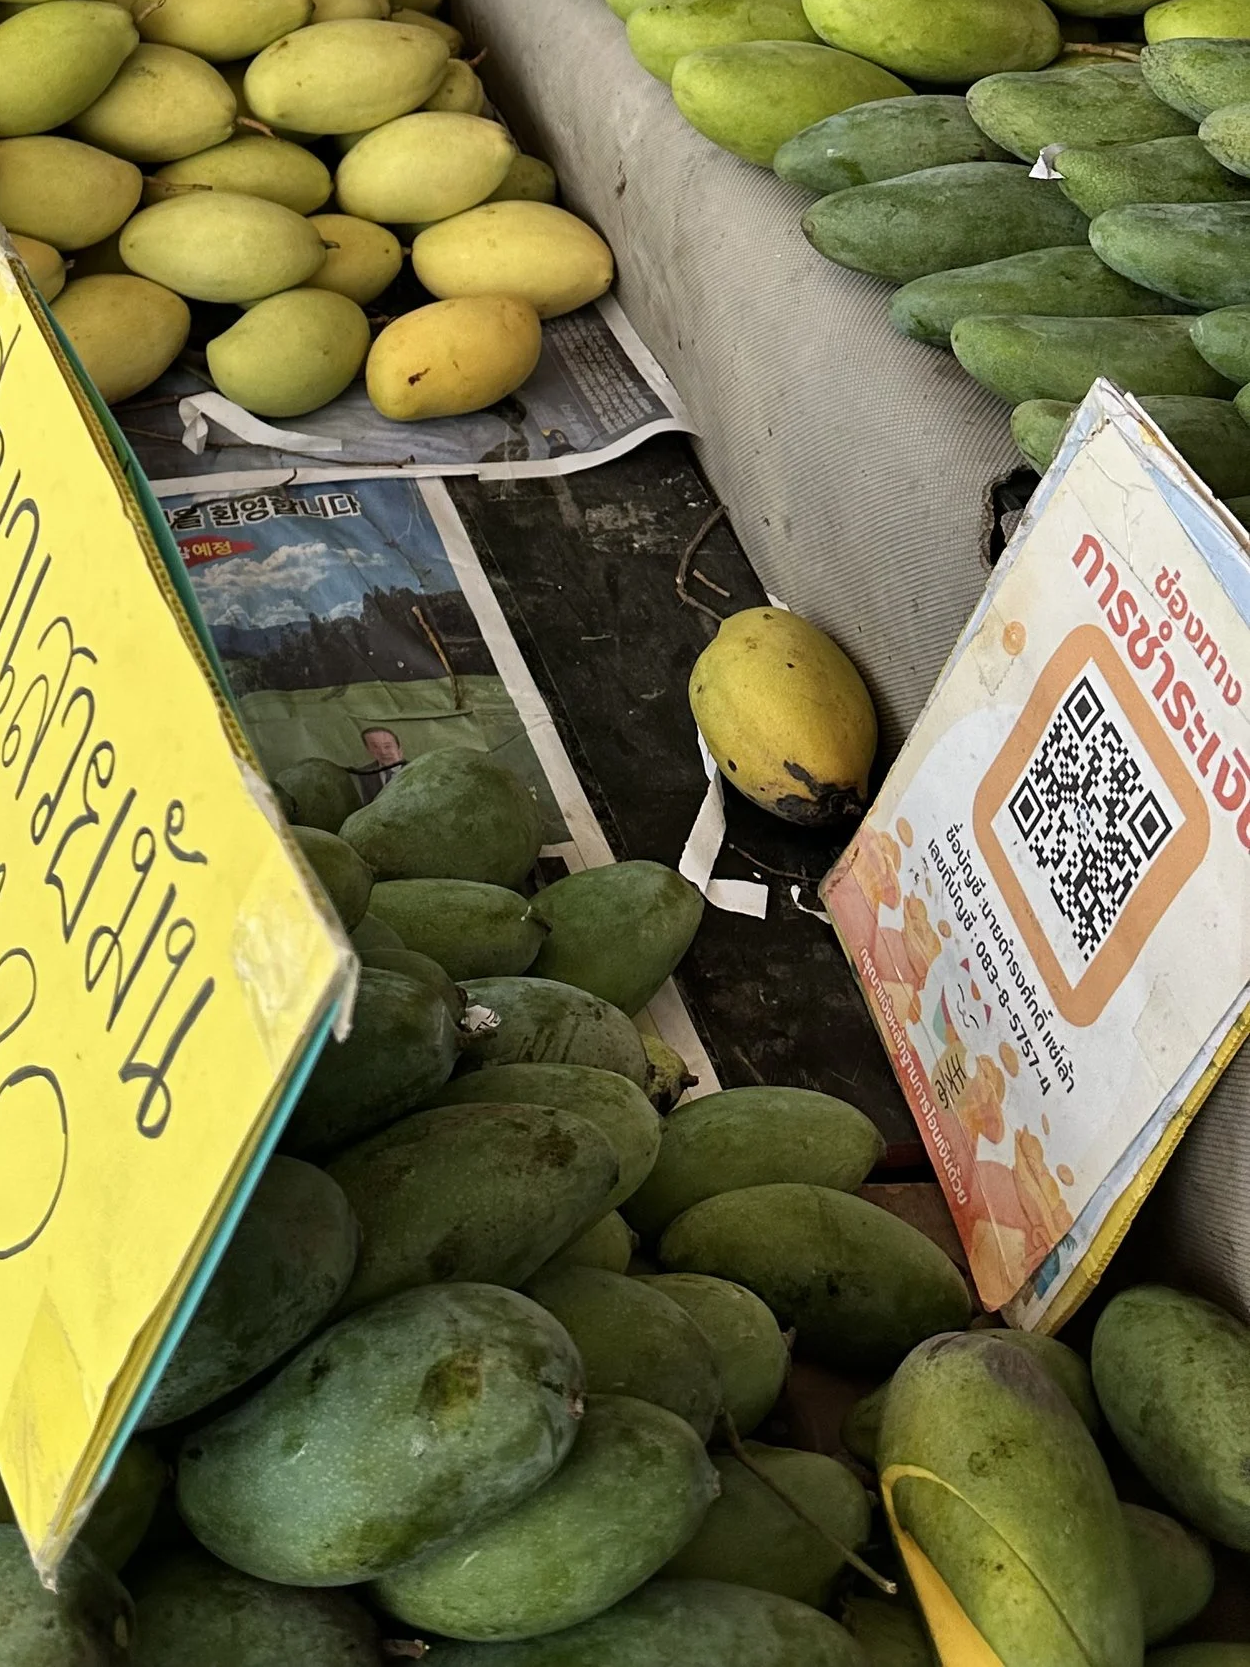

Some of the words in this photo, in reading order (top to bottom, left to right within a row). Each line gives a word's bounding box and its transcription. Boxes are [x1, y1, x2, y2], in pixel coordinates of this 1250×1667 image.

[191, 540, 232, 558] 예정
[209, 493, 361, 527] 환영합니다
[1154, 565, 1242, 707] ช่องทาง
[945, 822, 987, 900] ชื่อบัญชี
[928, 838, 978, 933] เลขที่บัญชี
[975, 940, 1051, 1097] 083-8-5757-4
[860, 946, 969, 1206] กรุณาแจ้งหลักฐานการโอนเงินด้วย
